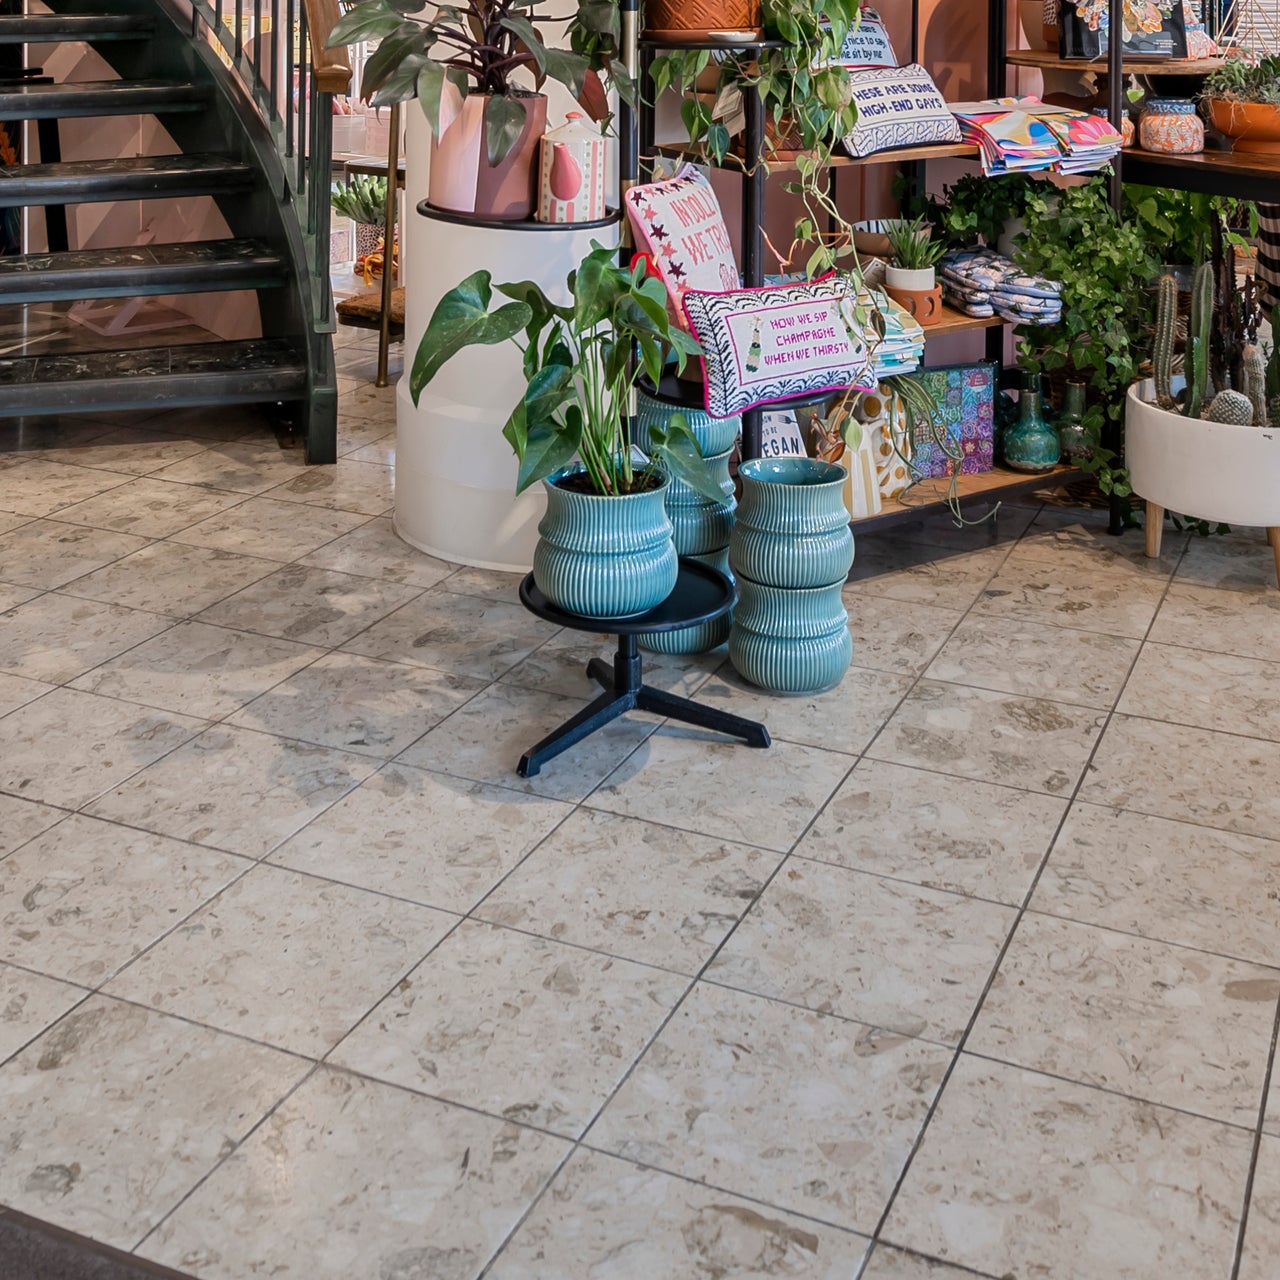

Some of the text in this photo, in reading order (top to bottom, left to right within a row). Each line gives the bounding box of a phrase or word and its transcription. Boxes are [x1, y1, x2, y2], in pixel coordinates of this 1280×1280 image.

[848, 36, 887, 49] nice to say
[852, 48, 861, 59] sit
[862, 48, 873, 61] by
[873, 50, 882, 59] me
[853, 83, 936, 101] HESE ARE SOME
[859, 97, 942, 118] HIGH-END GAYS
[683, 186, 720, 224] DOLLY
[682, 232, 714, 266] WE
[770, 311, 828, 330] NOW WE SIP
[776, 327, 836, 347] CHAMPAGNE
[764, 342, 849, 366] WHEN WE THIRSTY
[763, 415, 772, 423] OW
[770, 426, 778, 434] BE
[762, 437, 800, 458] EGAN
